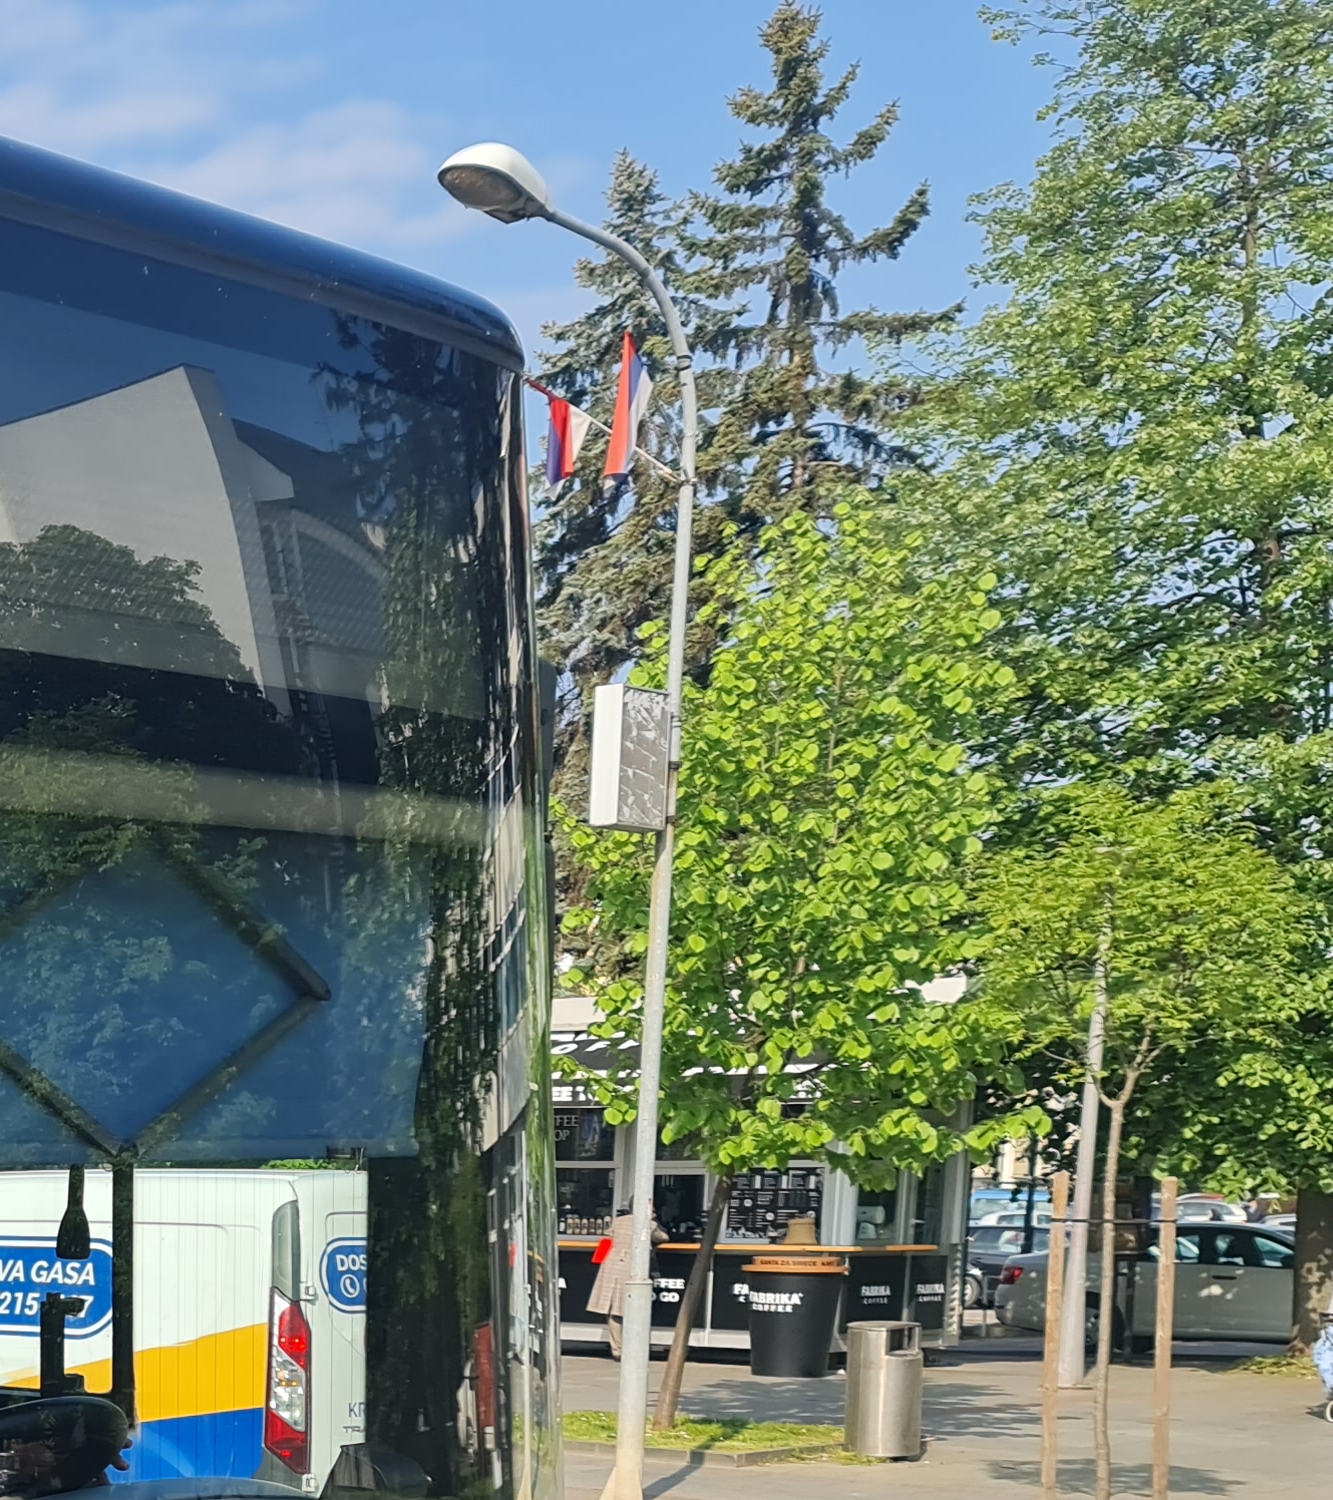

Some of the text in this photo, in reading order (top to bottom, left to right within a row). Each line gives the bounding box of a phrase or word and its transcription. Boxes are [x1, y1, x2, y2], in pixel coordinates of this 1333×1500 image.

[30, 1261, 96, 1286] GASA
[749, 1291, 802, 1305] FABRIKA
[752, 1303, 793, 1312] COFFEE
